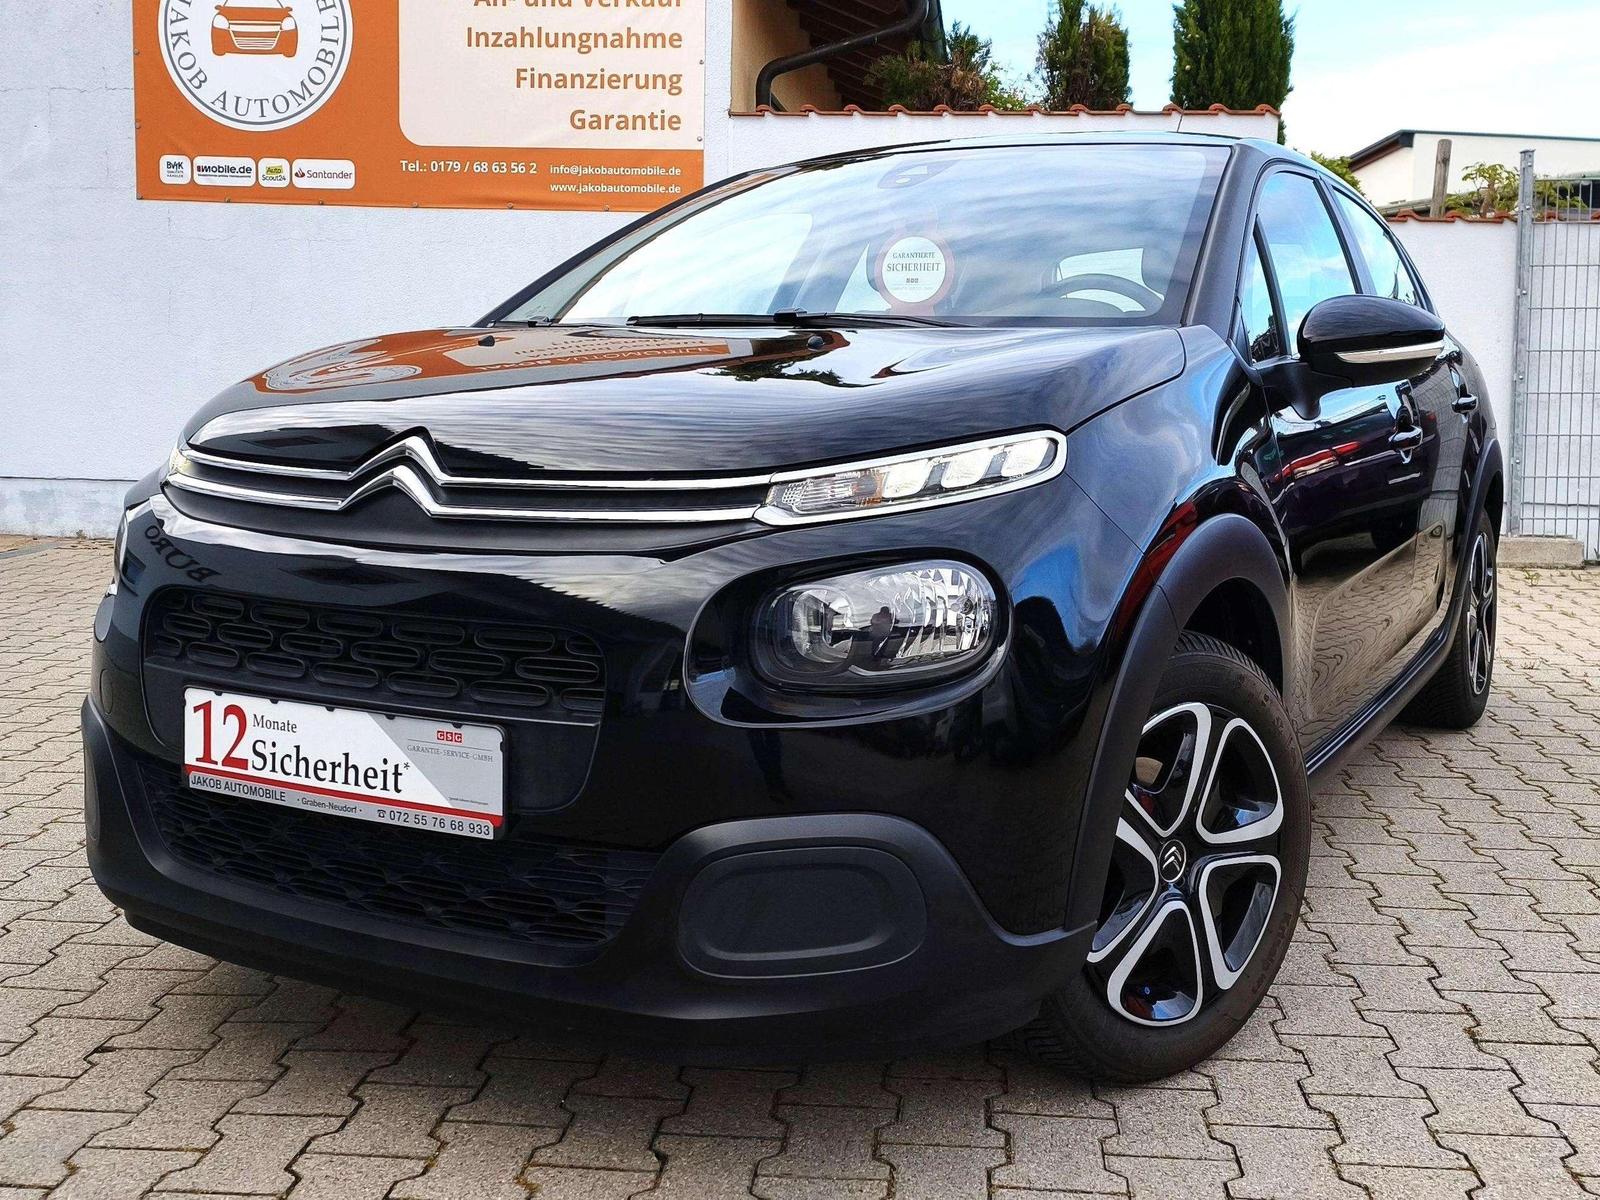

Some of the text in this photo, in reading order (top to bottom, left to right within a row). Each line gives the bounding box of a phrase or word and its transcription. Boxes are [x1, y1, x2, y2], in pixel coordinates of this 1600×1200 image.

[466, 26, 683, 54] Inzahlungnahme
[515, 67, 683, 96] Finanzierung
[569, 109, 682, 131] Garantie
[197, 164, 253, 174] mobile.de
[400, 160, 427, 172] Tel.:
[430, 160, 461, 173] 0179
[473, 161, 489, 174] 68
[491, 162, 508, 174] 63
[510, 162, 526, 174] 56
[529, 162, 537, 174] 2
[549, 164, 682, 177] info@jakobautomobile.de
[261, 174, 286, 182] Scout24
[306, 169, 353, 180] Santander
[549, 182, 681, 194] www.jakobautomobile.de
[892, 251, 936, 259] GARANTIERTE
[886, 262, 941, 272] SICHERHEIT
[253, 714, 297, 733] Monate
[193, 700, 249, 771] 12
[437, 730, 463, 744] GSG
[191, 775, 491, 837] JAKOB AUTOMOBILE Graben-Neudorf 072 55 76 68 933
